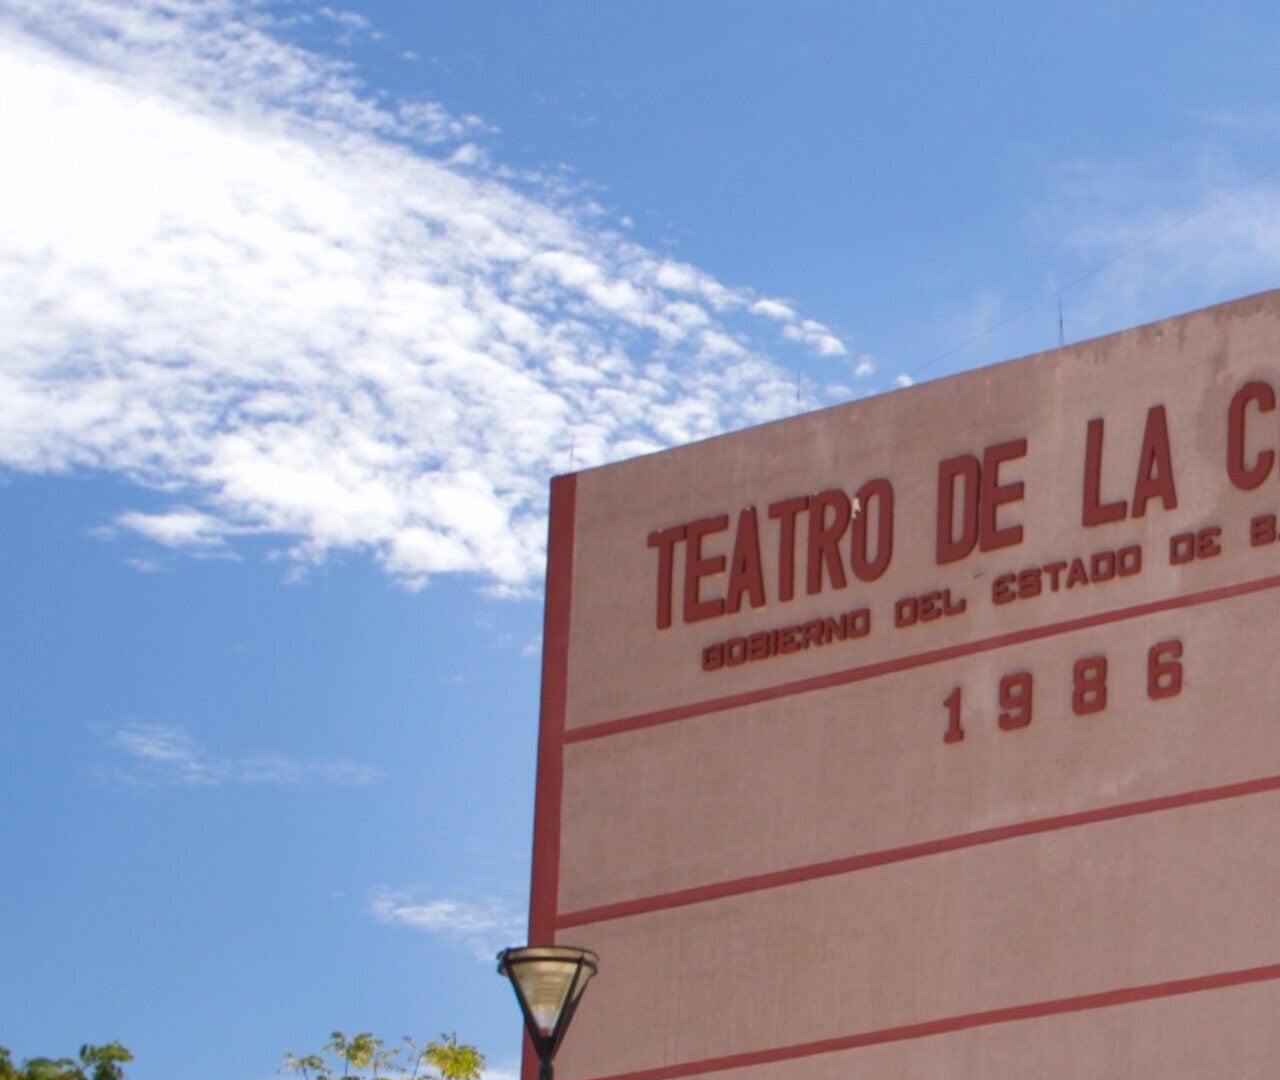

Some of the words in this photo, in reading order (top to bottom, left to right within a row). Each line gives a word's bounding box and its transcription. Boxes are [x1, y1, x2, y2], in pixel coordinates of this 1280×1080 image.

[647, 477, 895, 631] TEATRO
[935, 437, 1029, 568] DE
[1081, 404, 1179, 528] LA
[702, 607, 872, 672] GOBIERNO
[893, 588, 968, 630] DEL
[991, 544, 1144, 607] ESTADO
[1168, 526, 1223, 567] DE
[942, 638, 1184, 746] 1986
